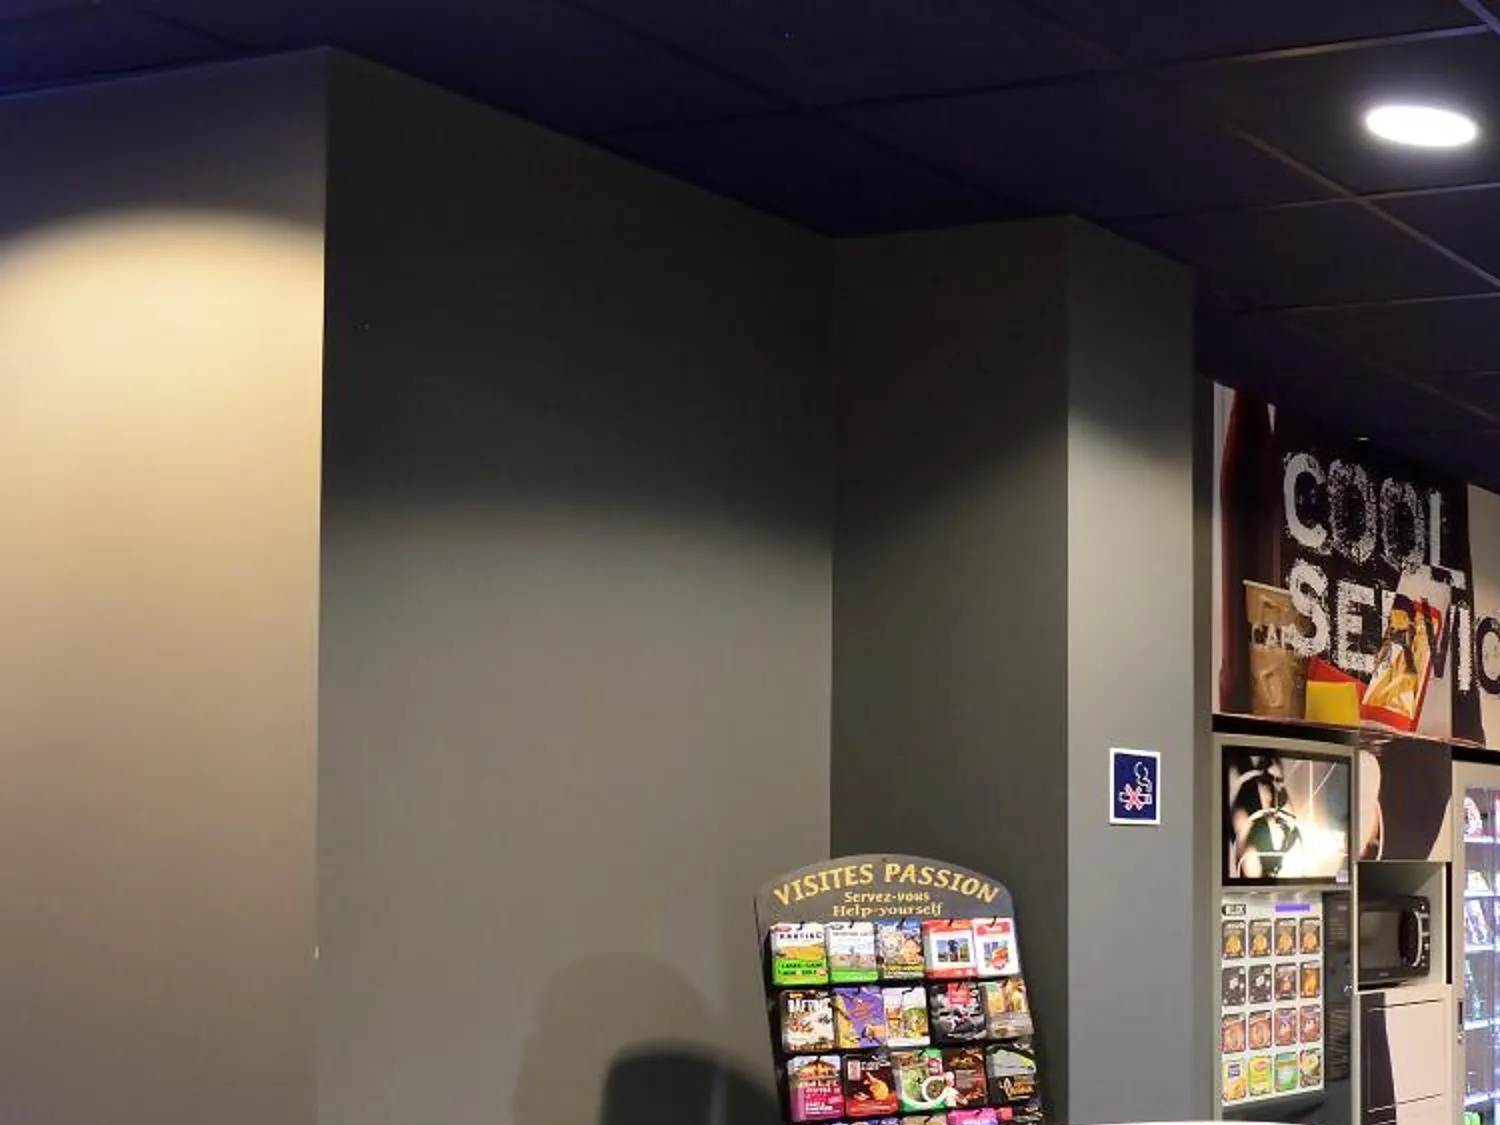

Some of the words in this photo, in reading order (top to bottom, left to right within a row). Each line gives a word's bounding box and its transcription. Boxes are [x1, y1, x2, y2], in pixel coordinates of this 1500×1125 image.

[1282, 451, 1466, 592] COOL
[773, 863, 873, 906] VISITES
[884, 863, 1000, 904] PASSION
